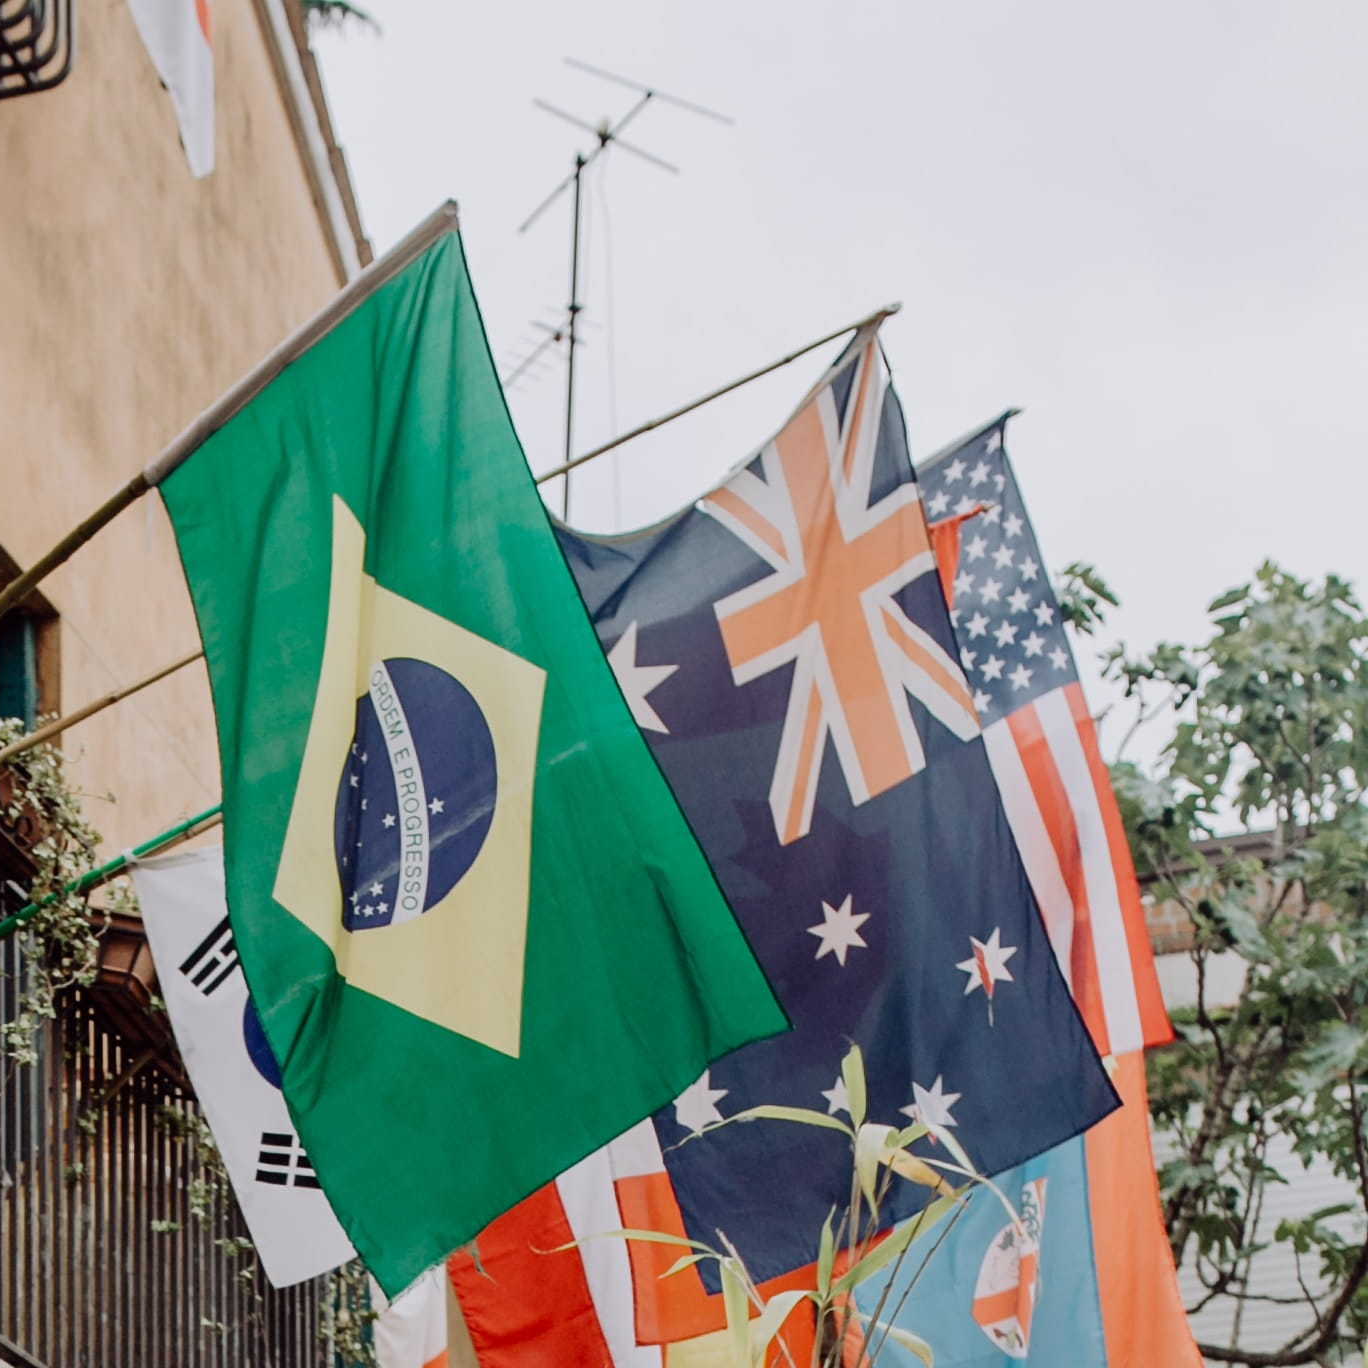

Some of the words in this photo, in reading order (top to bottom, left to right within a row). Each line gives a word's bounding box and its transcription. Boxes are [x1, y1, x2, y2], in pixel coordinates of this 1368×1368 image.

[370, 669, 405, 740] ORDEM
[394, 747, 411, 764] E
[397, 767, 424, 911] PROGRESSO
